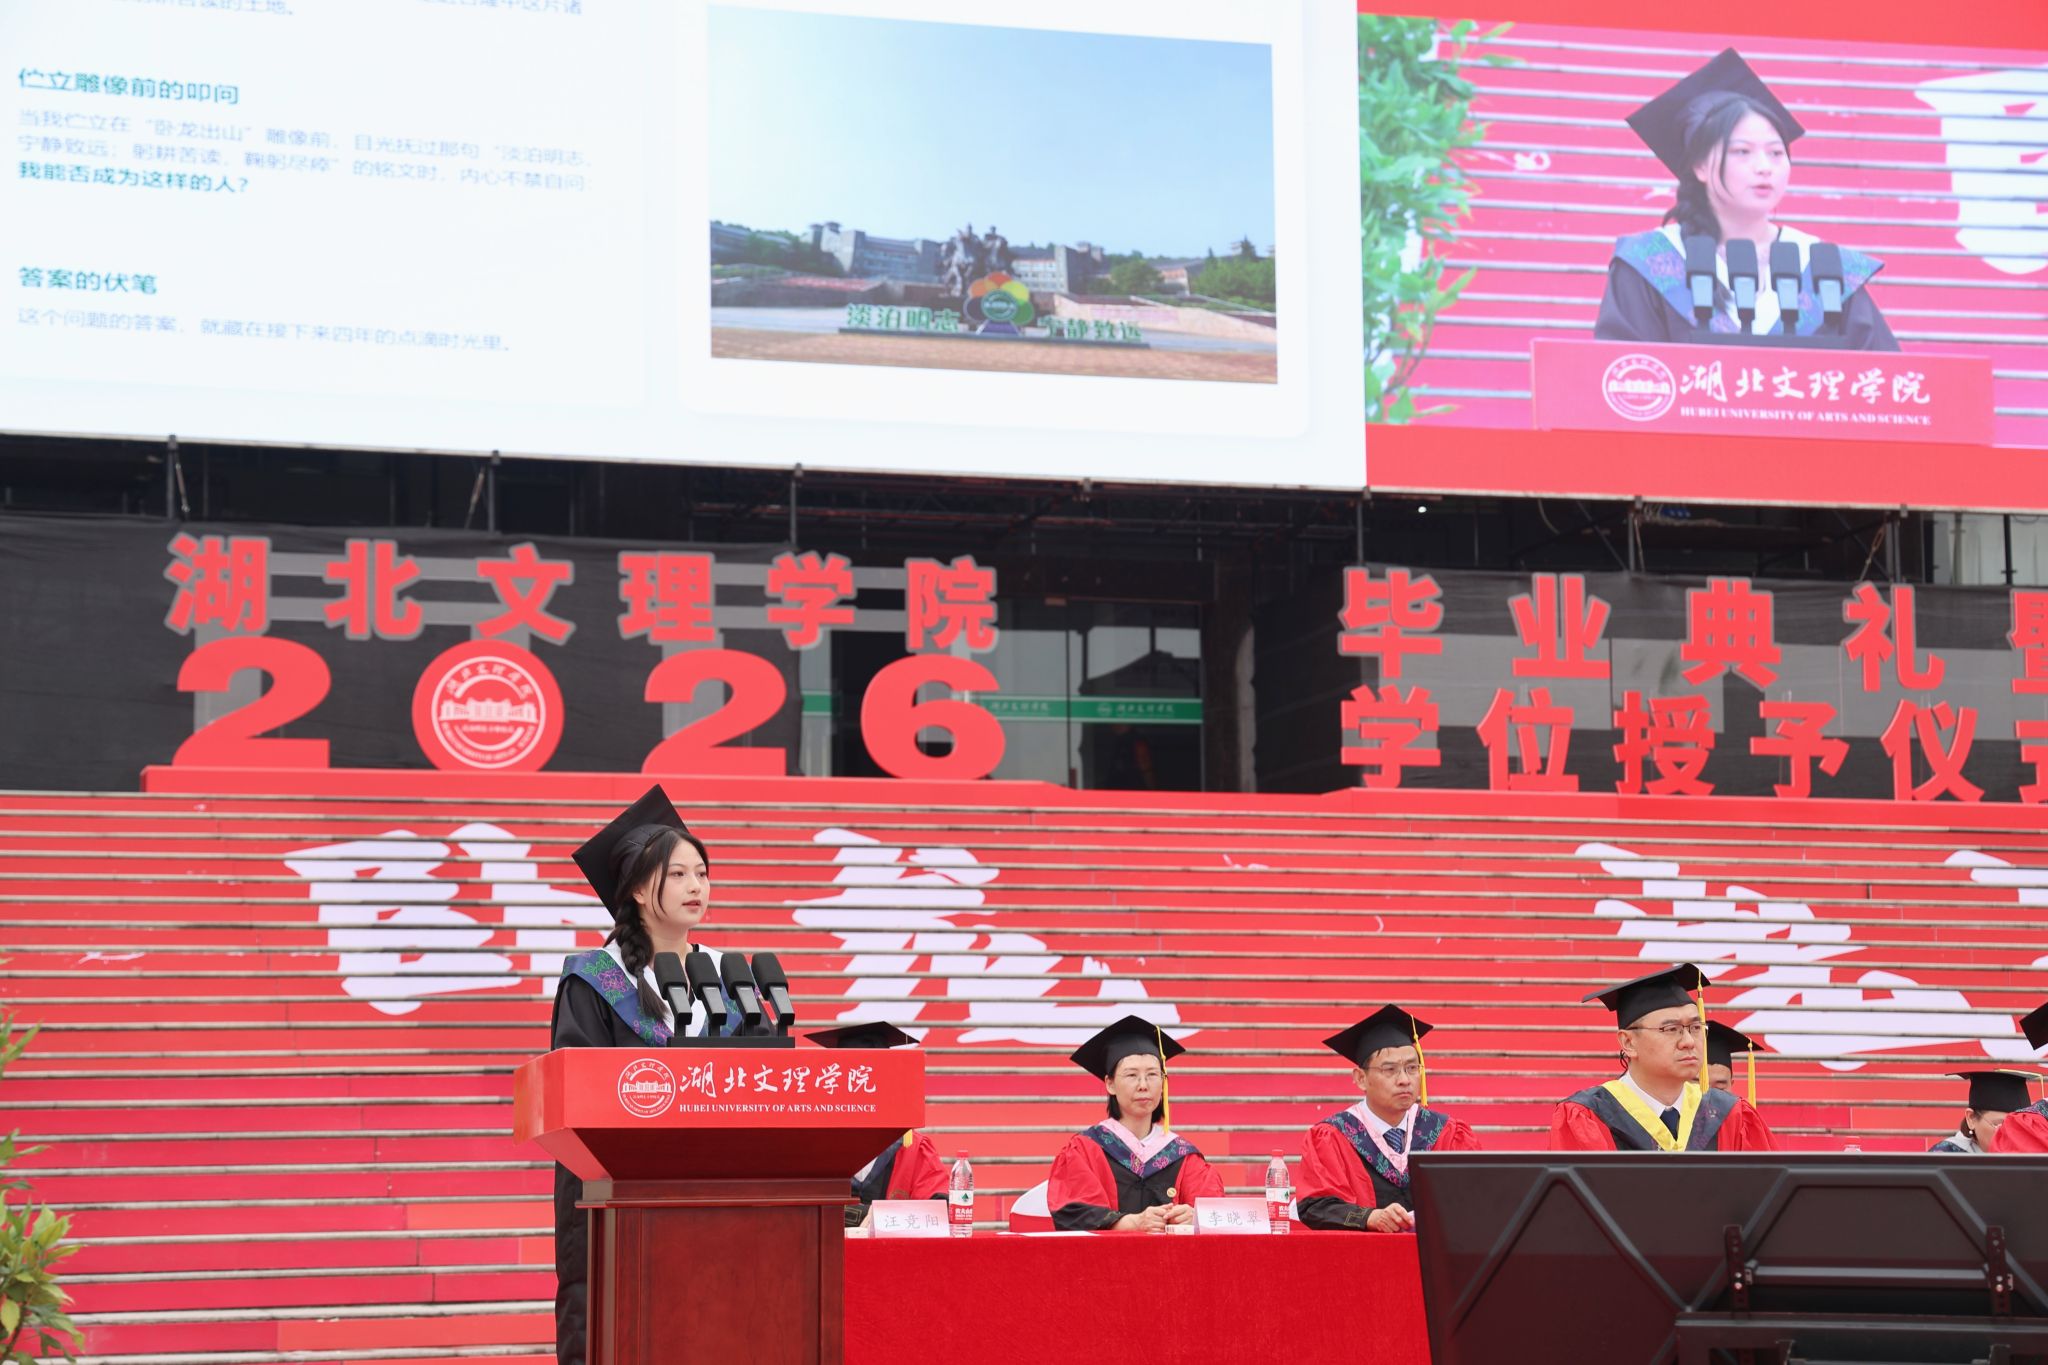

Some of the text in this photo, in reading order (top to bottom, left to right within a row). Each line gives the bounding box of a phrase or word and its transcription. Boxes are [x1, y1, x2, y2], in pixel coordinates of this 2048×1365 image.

[18, 66, 239, 105] 伫立雕像前的叩问
[18, 266, 159, 295] 答案的伏笔
[1679, 360, 1931, 404] 湖北文理学院
[1680, 406, 1719, 417] HUBEI
[1721, 408, 1795, 421] UNIVERSITY
[1797, 412, 1815, 421] OF
[1817, 412, 1849, 423] ARTS
[1851, 414, 1877, 424] AND
[1877, 415, 1932, 426] SCIENCE
[164, 533, 998, 652] 湖北文理学院
[679, 1061, 877, 1098] 湖北文理学院
[679, 1104, 710, 1113] HUBEI
[711, 1104, 771, 1113] UNIVERSITY
[772, 1104, 786, 1113] OF
[787, 1104, 812, 1113] ARTS
[813, 1104, 834, 1113] AND
[834, 1104, 877, 1113] SCIENCE
